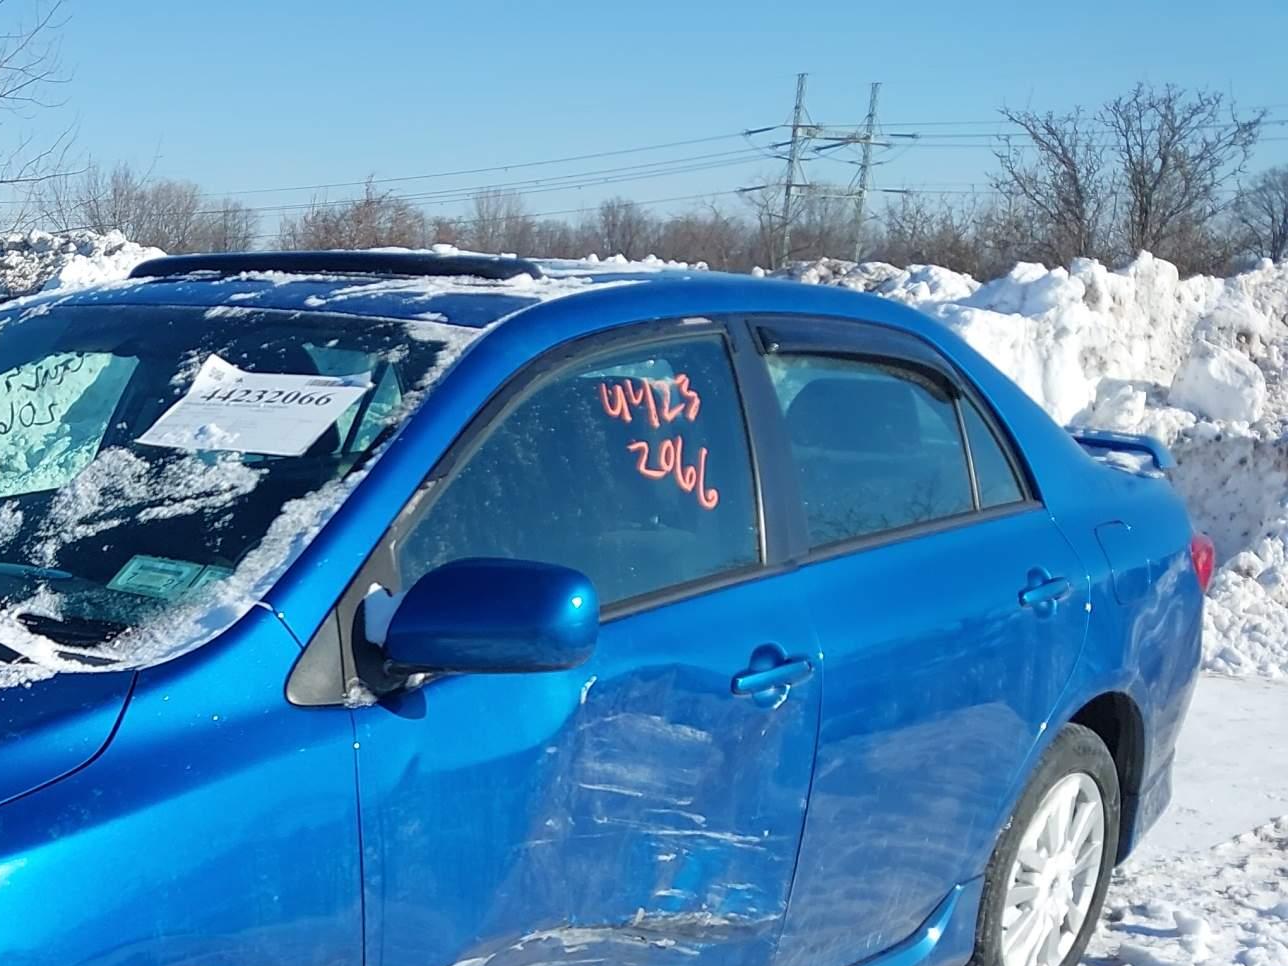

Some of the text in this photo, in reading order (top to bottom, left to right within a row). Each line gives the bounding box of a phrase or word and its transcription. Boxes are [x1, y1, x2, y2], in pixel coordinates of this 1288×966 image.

[200, 387, 335, 406] 44232066
[600, 374, 700, 428] 4423
[626, 435, 720, 509] 2066
